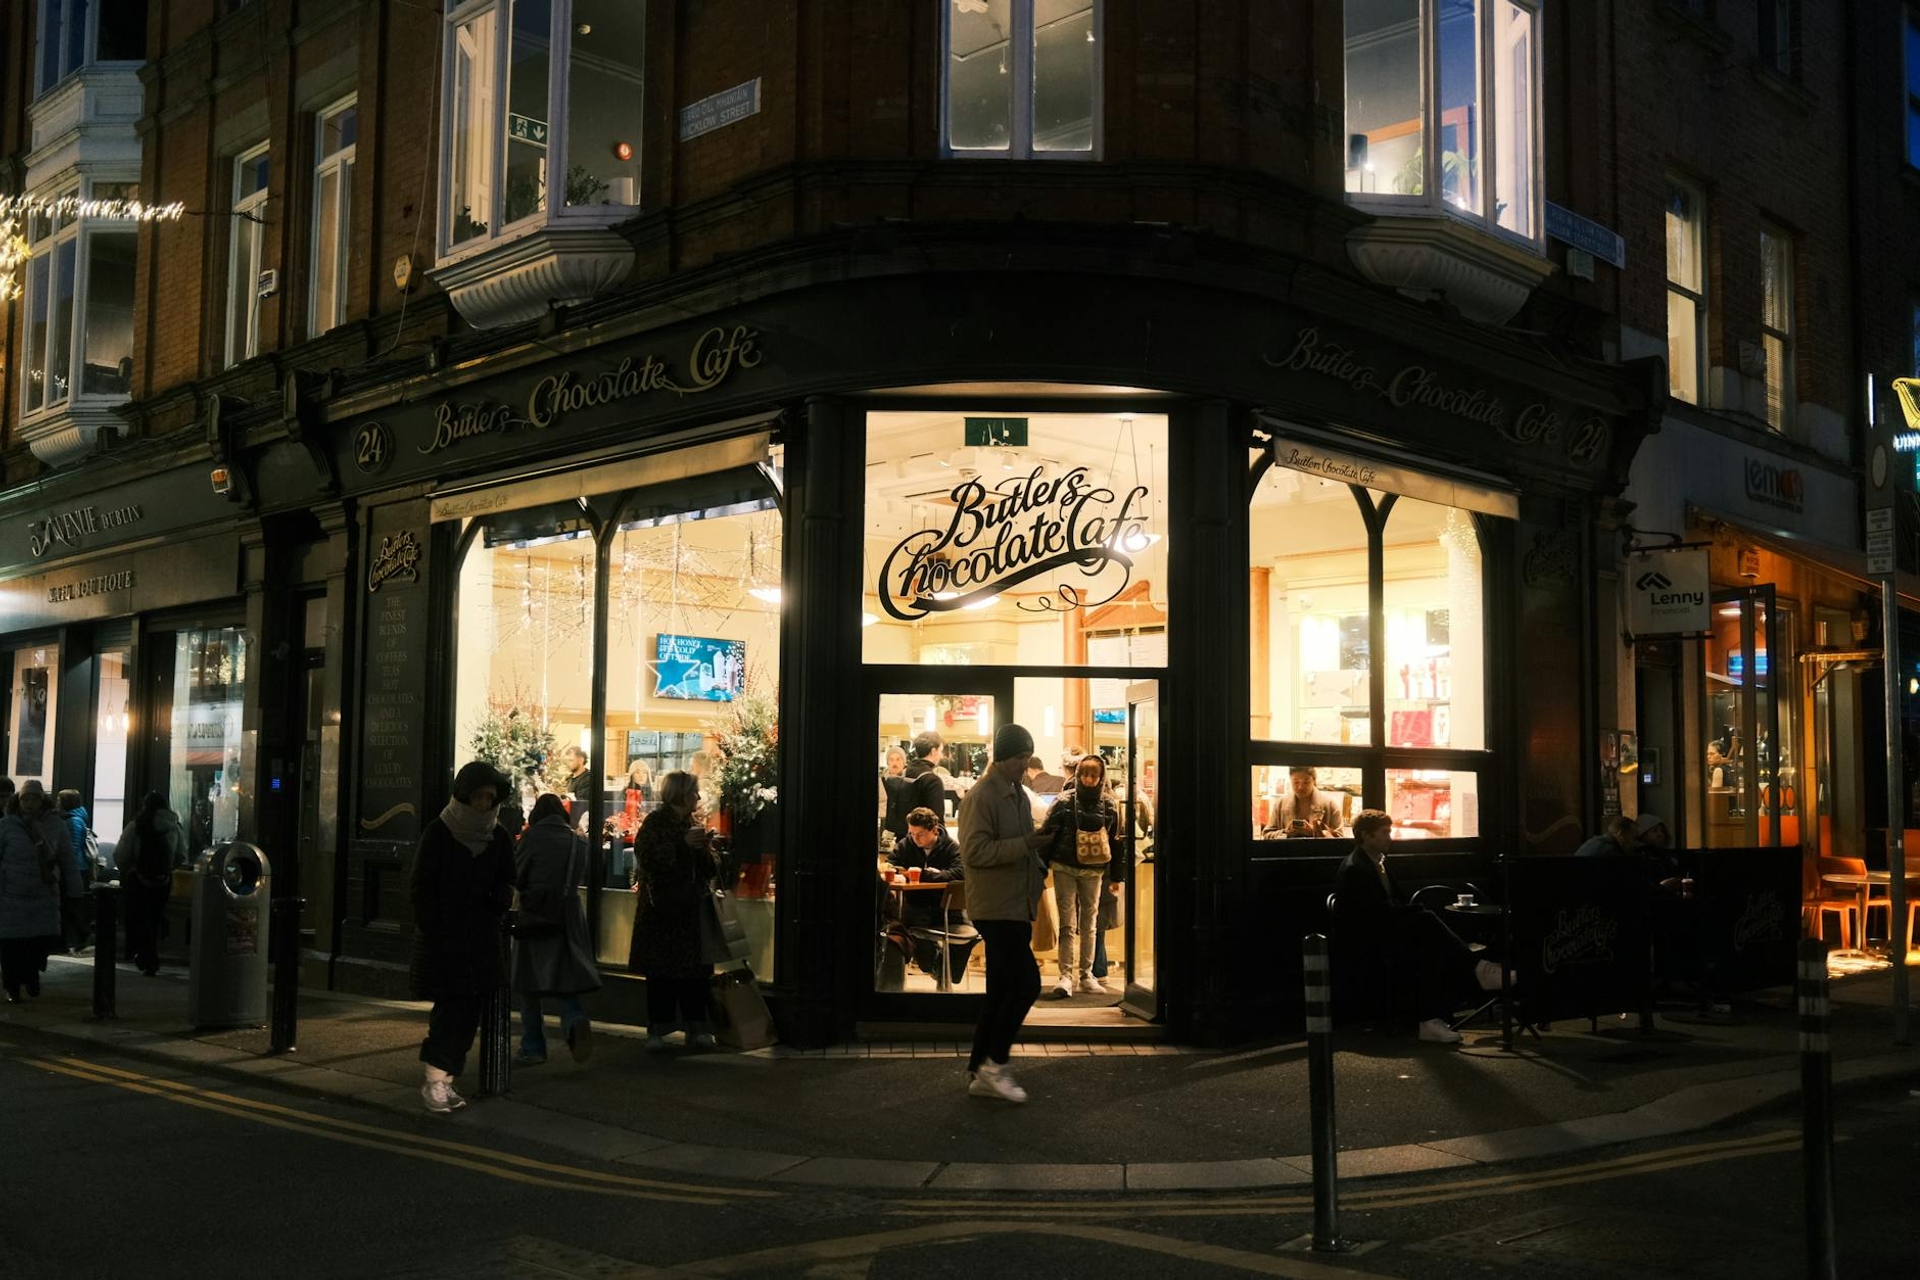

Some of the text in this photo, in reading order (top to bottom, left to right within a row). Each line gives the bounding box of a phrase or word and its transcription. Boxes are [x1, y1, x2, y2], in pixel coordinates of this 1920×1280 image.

[720, 101, 750, 123] STREET
[417, 325, 762, 454] Butlers Chocolate Café
[1263, 327, 1562, 443] Butlers Chocolate Café
[358, 427, 384, 463] 24
[1572, 424, 1601, 461] 24
[1321, 457, 1358, 480] Chocolate
[101, 506, 141, 530] DUBLIN
[927, 466, 1091, 554] Butlers
[879, 486, 1152, 621] Chocolate Café
[75, 571, 131, 598] BOUTIQUE
[1651, 592, 1703, 605] Lenny
[386, 597, 401, 607] THE
